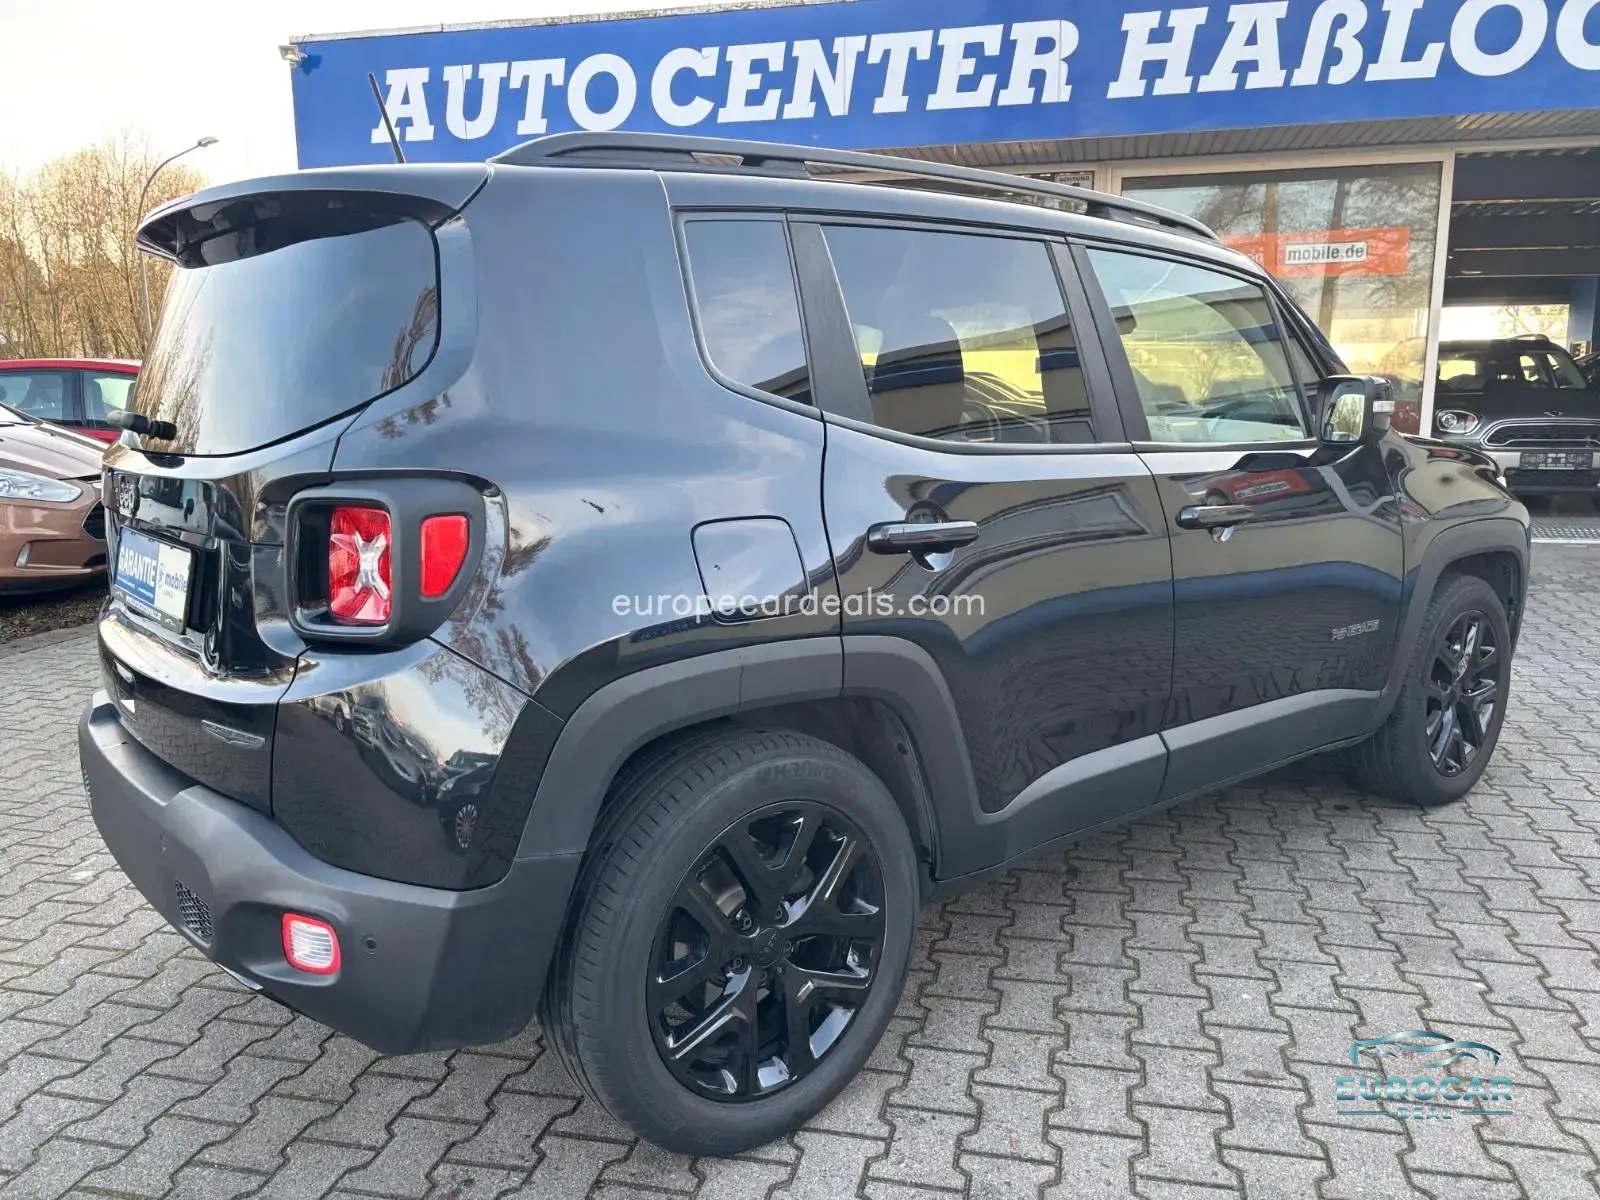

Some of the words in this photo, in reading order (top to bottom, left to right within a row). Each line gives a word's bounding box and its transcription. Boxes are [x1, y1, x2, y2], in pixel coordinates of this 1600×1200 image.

[371, 53, 637, 143] AUTO
[651, 25, 1080, 125] CENTER
[1287, 244, 1364, 261] mobile.de
[117, 546, 157, 589] GARANTIE
